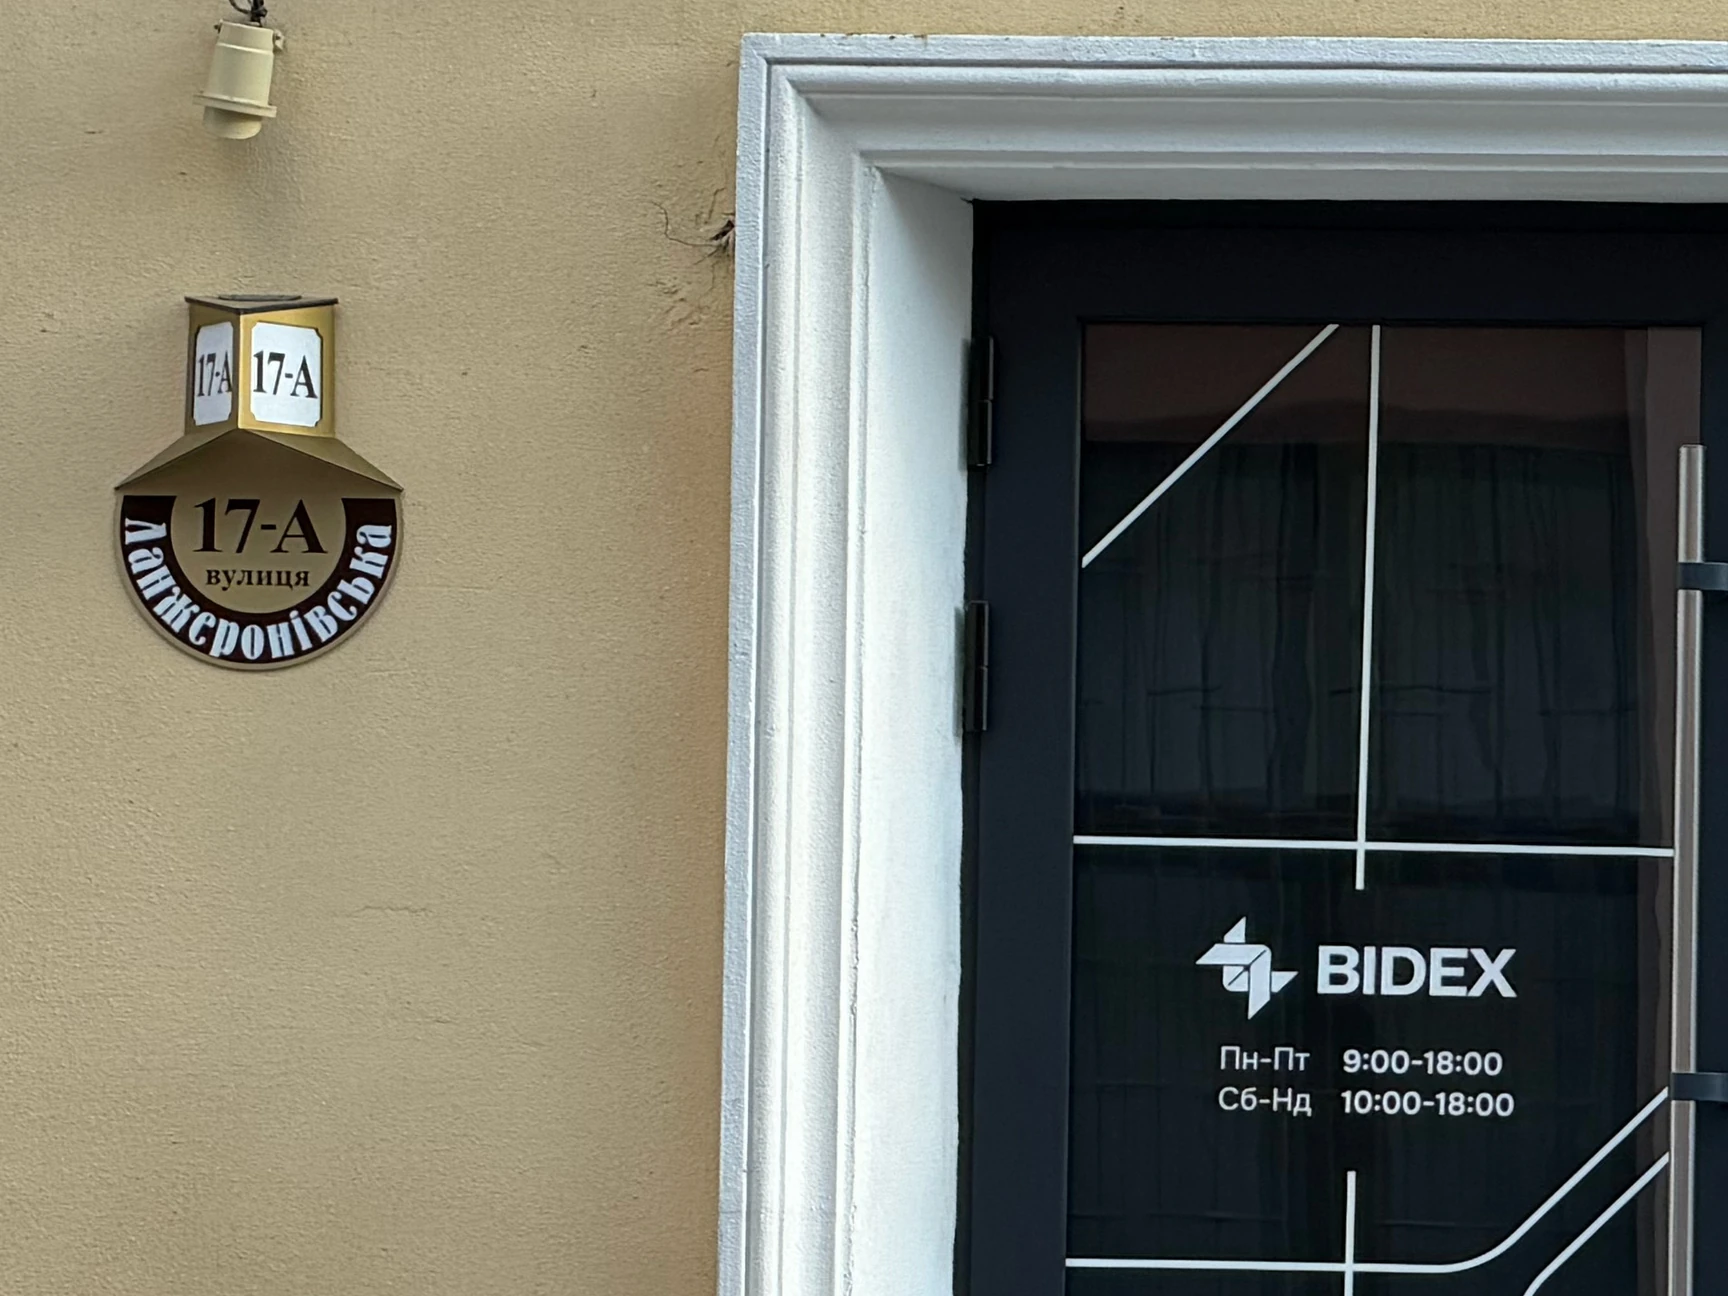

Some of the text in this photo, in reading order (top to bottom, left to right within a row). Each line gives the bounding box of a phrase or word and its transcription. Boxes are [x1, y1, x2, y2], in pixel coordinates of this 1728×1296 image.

[252, 349, 319, 399] 17-А
[192, 497, 328, 554] 17-А
[124, 516, 393, 661] Ланжеронівська
[205, 568, 311, 592] вулиця
[1316, 944, 1518, 998] BIDEX
[1219, 1045, 1504, 1076] Пн-Пт 9:00-18:00
[1217, 1085, 1516, 1117] Сб-Нд 10:00-18:00
